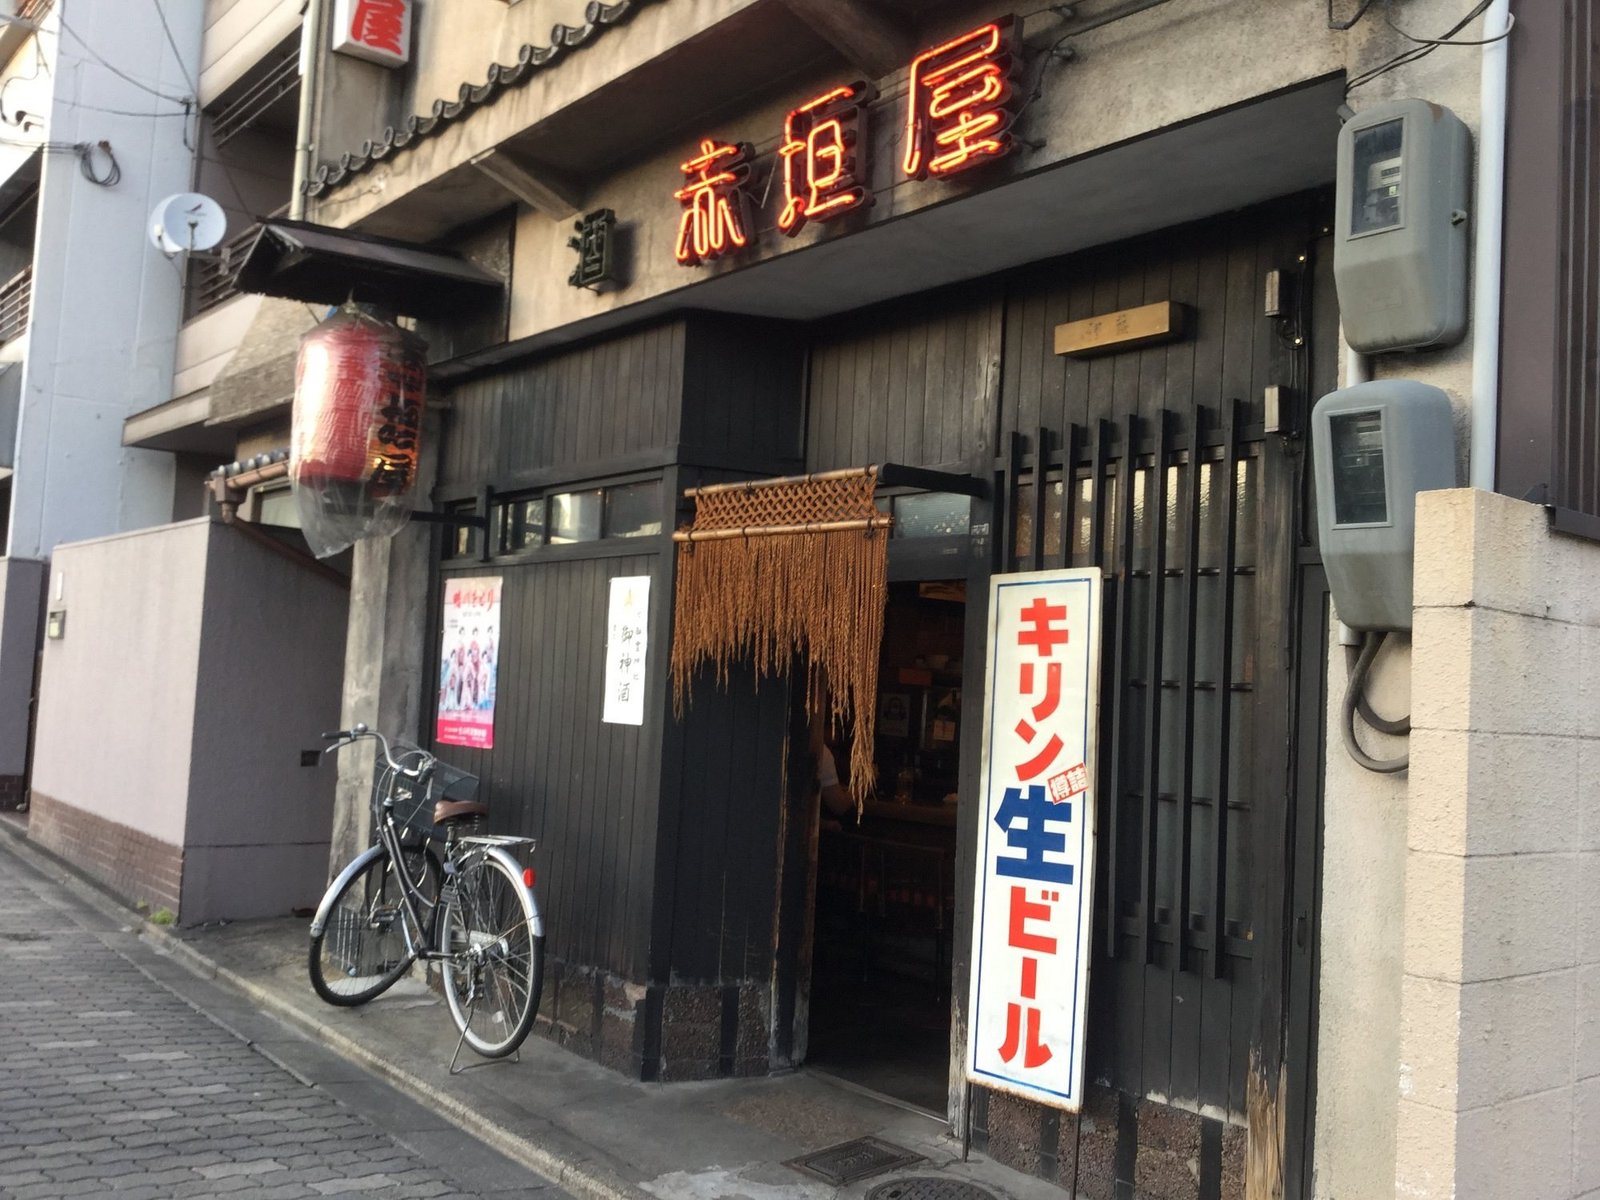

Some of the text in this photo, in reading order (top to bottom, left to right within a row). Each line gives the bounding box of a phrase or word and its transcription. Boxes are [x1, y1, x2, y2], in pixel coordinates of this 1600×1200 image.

[672, 24, 1002, 265] 赤垣屋
[567, 208, 616, 288] 酒
[993, 597, 1075, 1070] キリン生ビール
[1049, 764, 1088, 802] 樽詰
